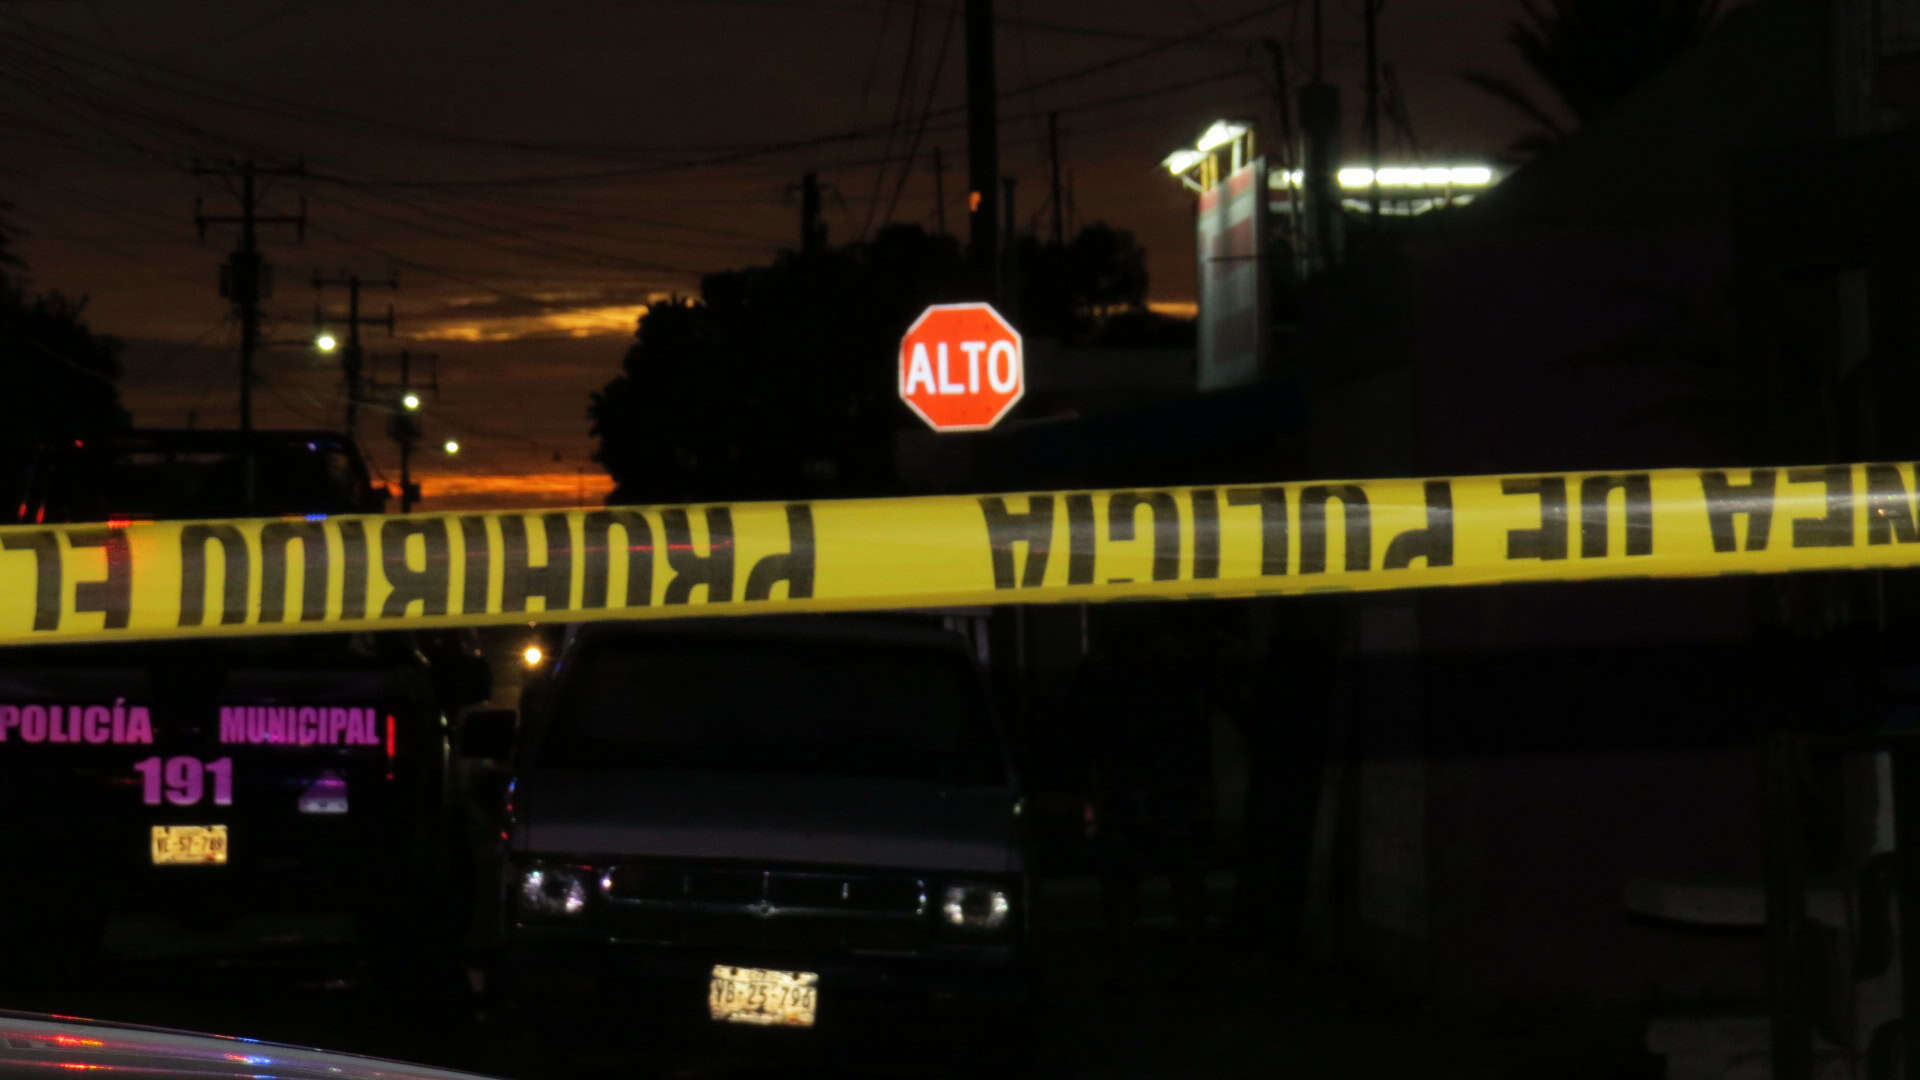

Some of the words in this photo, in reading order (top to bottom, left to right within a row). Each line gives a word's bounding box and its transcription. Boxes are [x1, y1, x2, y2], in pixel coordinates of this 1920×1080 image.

[906, 340, 1017, 395] ALTO
[0, 527, 132, 632] EL
[0, 697, 153, 744] POLICÍA
[219, 705, 379, 745] MUNICIPAL
[133, 756, 233, 806] 191
